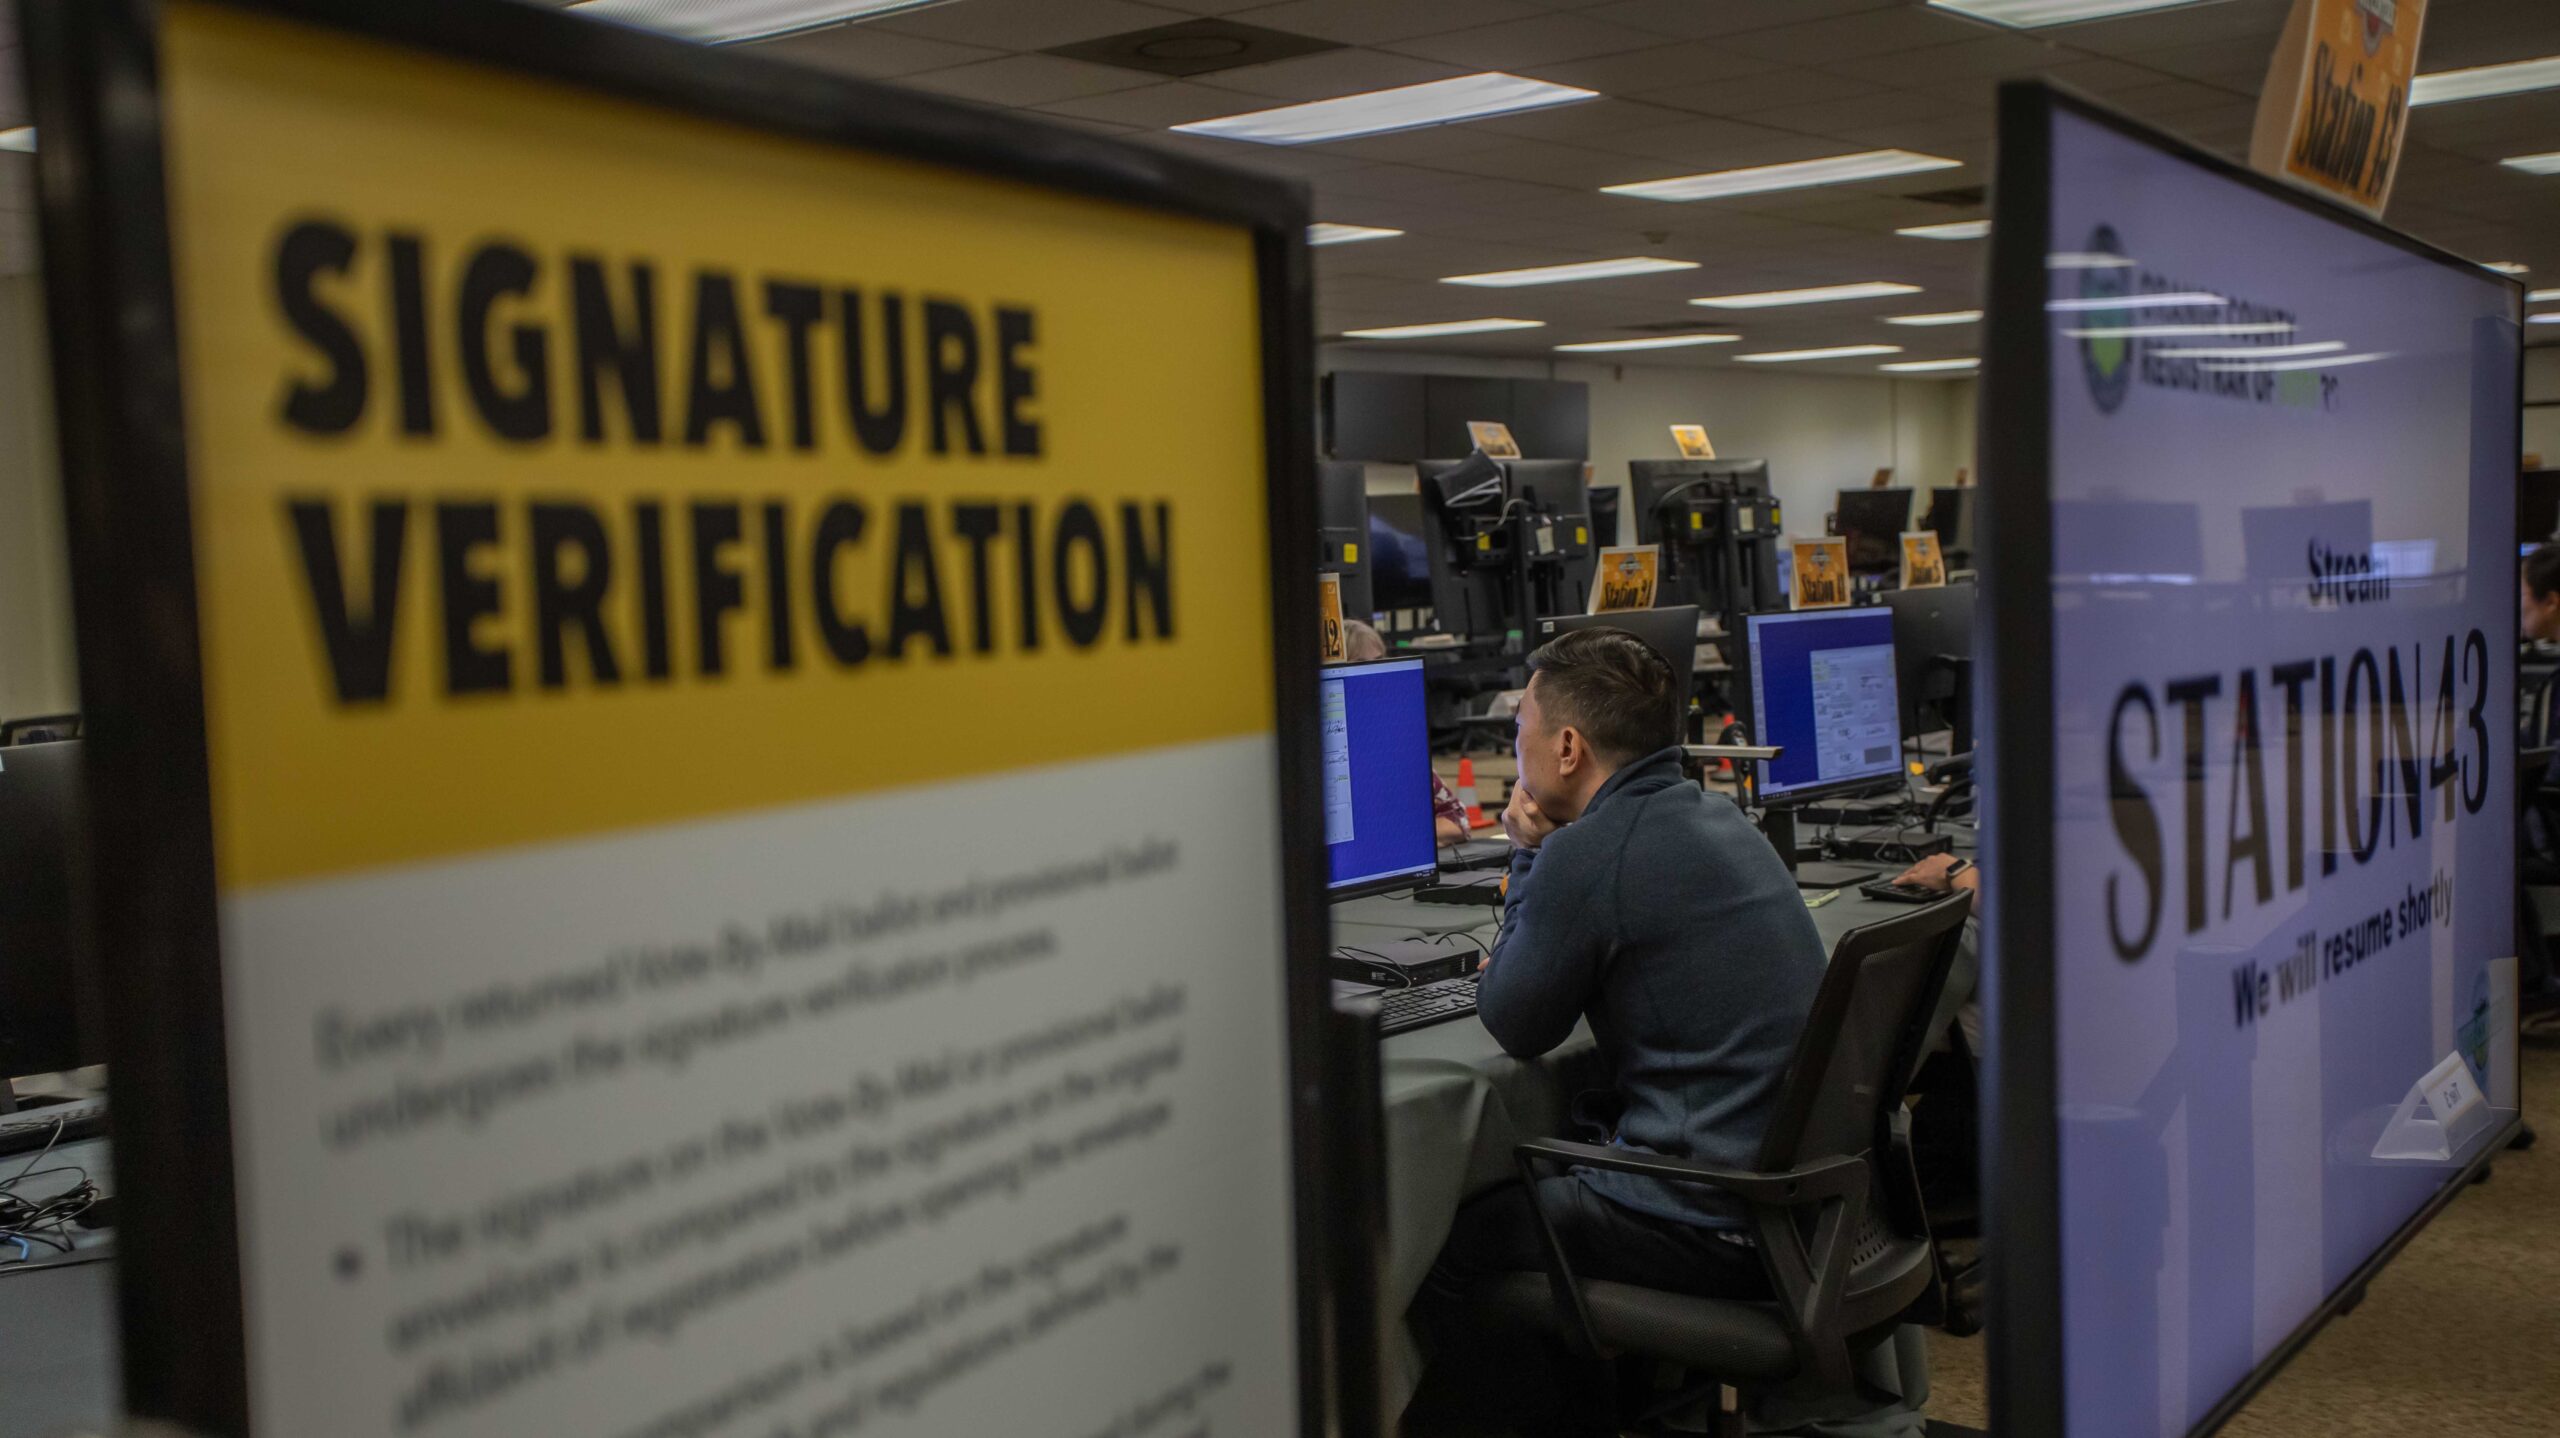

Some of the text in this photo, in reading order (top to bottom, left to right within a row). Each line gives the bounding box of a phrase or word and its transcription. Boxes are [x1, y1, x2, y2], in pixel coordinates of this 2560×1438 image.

[2296, 40, 2375, 190] Station
[273, 223, 1045, 457] SIGNATURE
[285, 495, 1175, 709] VERIFICATION
[1602, 581, 1638, 609] Station
[2307, 538, 2391, 607] Stream
[2107, 642, 2422, 964] STATION
[2428, 628, 2490, 824] 43
[2233, 868, 2453, 1030] We will resume shortly
